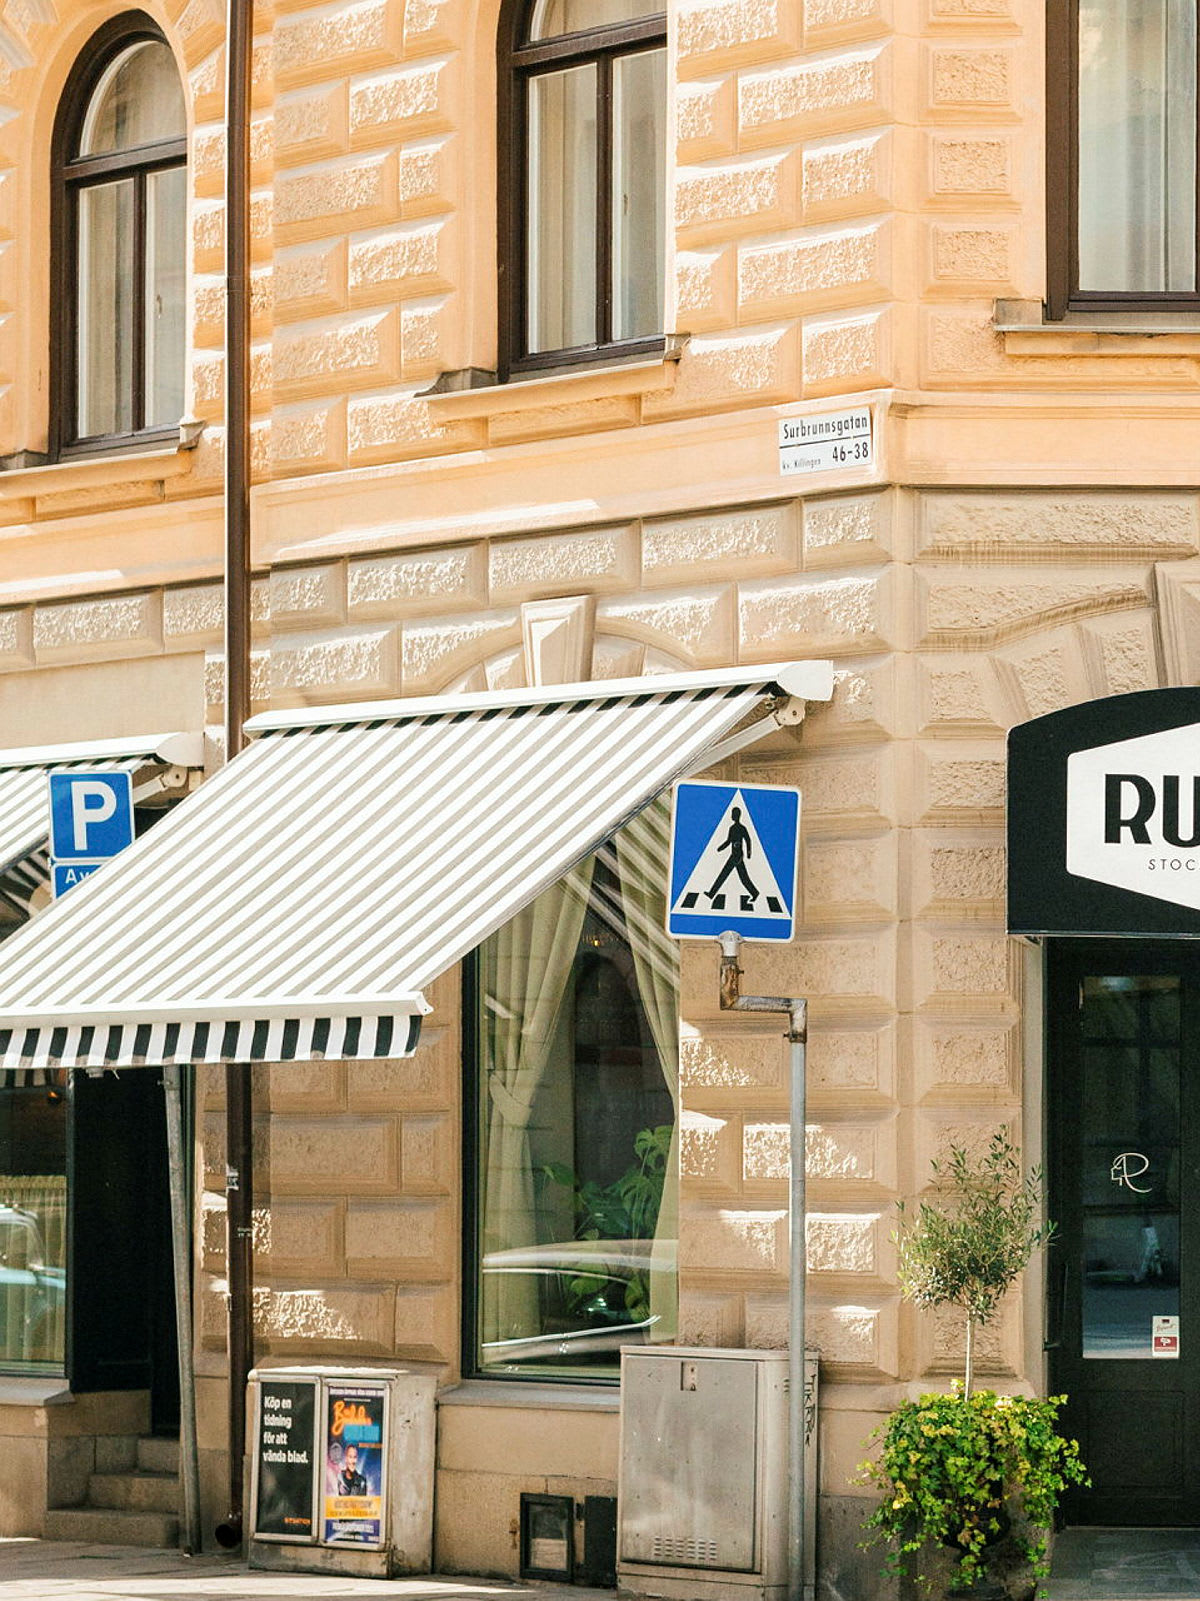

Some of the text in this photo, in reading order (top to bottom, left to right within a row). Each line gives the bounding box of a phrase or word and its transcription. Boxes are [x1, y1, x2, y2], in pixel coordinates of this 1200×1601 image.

[783, 416, 868, 439] Surbrunnsgatan
[832, 441, 869, 462] 46-38
[70, 781, 117, 851] P
[264, 1395, 292, 1411] Köp en
[264, 1413, 292, 1429] tidning
[263, 1431, 288, 1445] för att
[262, 1449, 309, 1464] vända blad.
